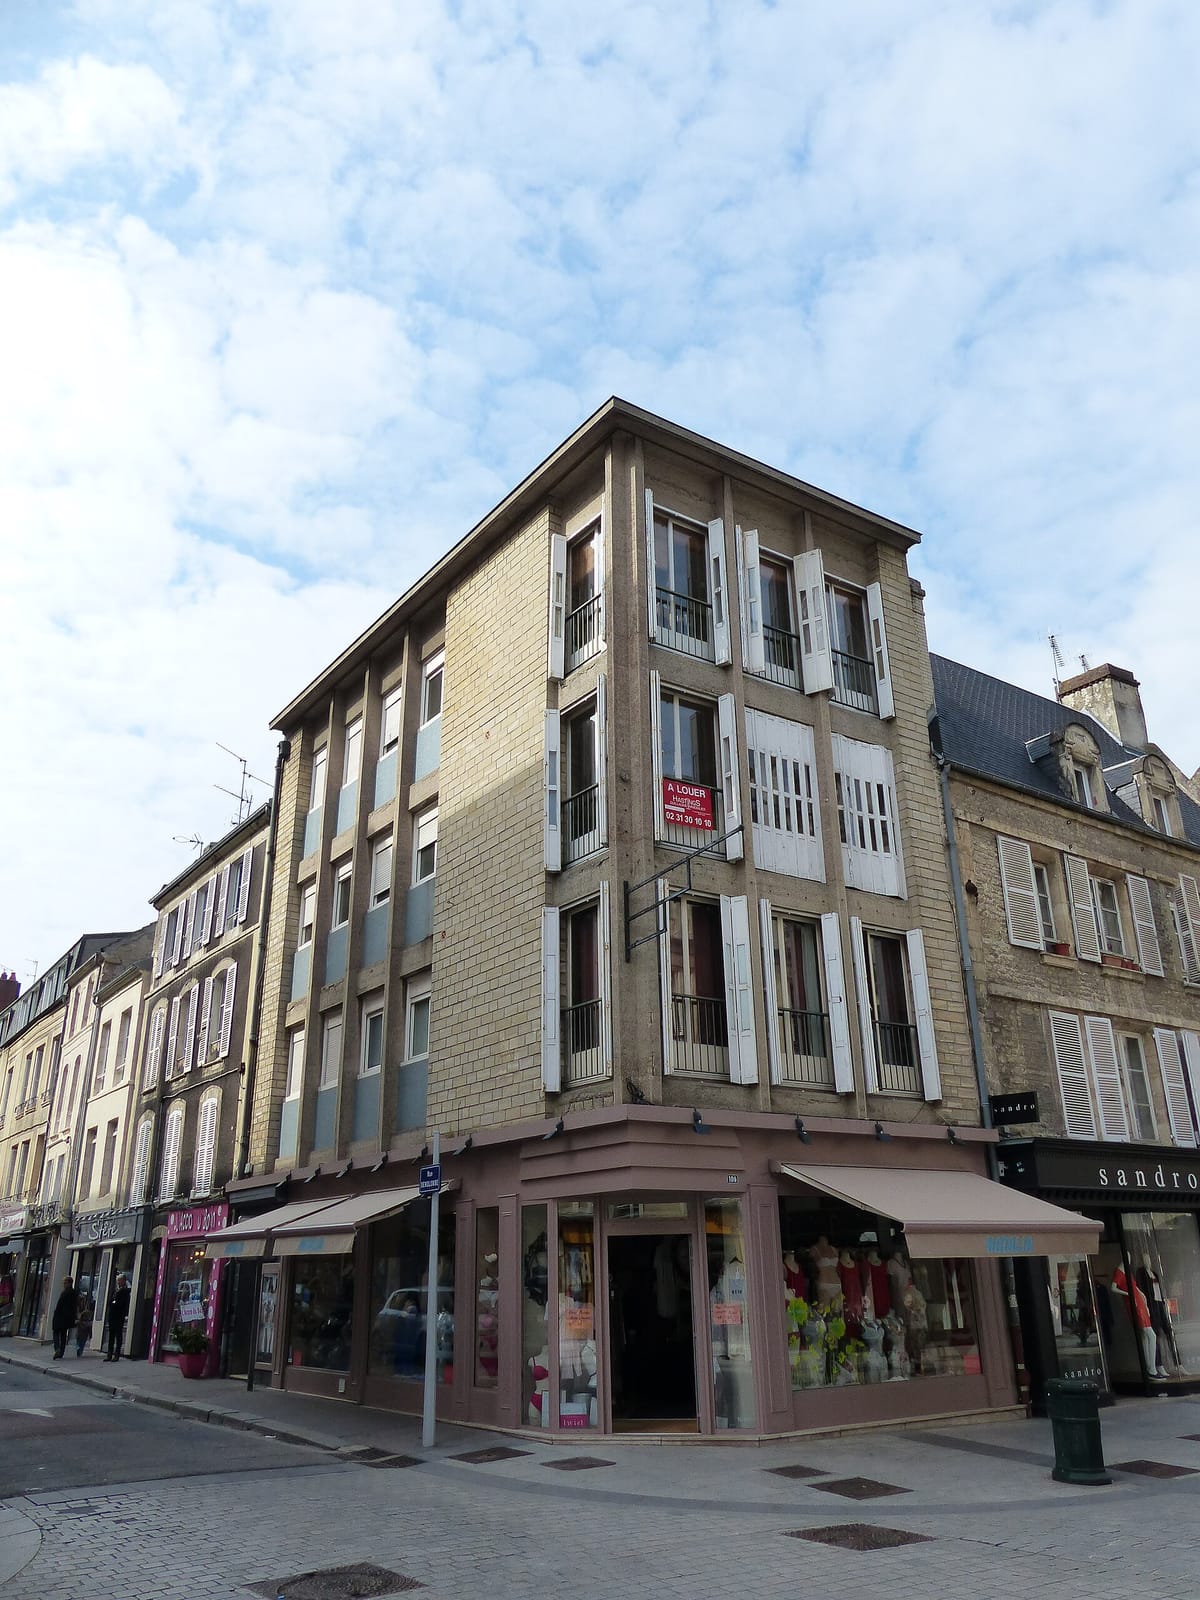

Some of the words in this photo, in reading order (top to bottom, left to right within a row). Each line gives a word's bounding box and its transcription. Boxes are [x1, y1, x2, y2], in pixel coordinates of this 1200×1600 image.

[667, 783, 675, 792] A
[676, 784, 706, 798] LOUER
[665, 811, 675, 820] 02
[675, 813, 683, 822] 31
[684, 815, 693, 824] 30
[695, 817, 702, 826] 10
[704, 819, 712, 828] 10
[994, 1102, 1035, 1112] sandro
[1099, 1164, 1198, 1189] sandro
[1064, 1367, 1101, 1379] sandro
